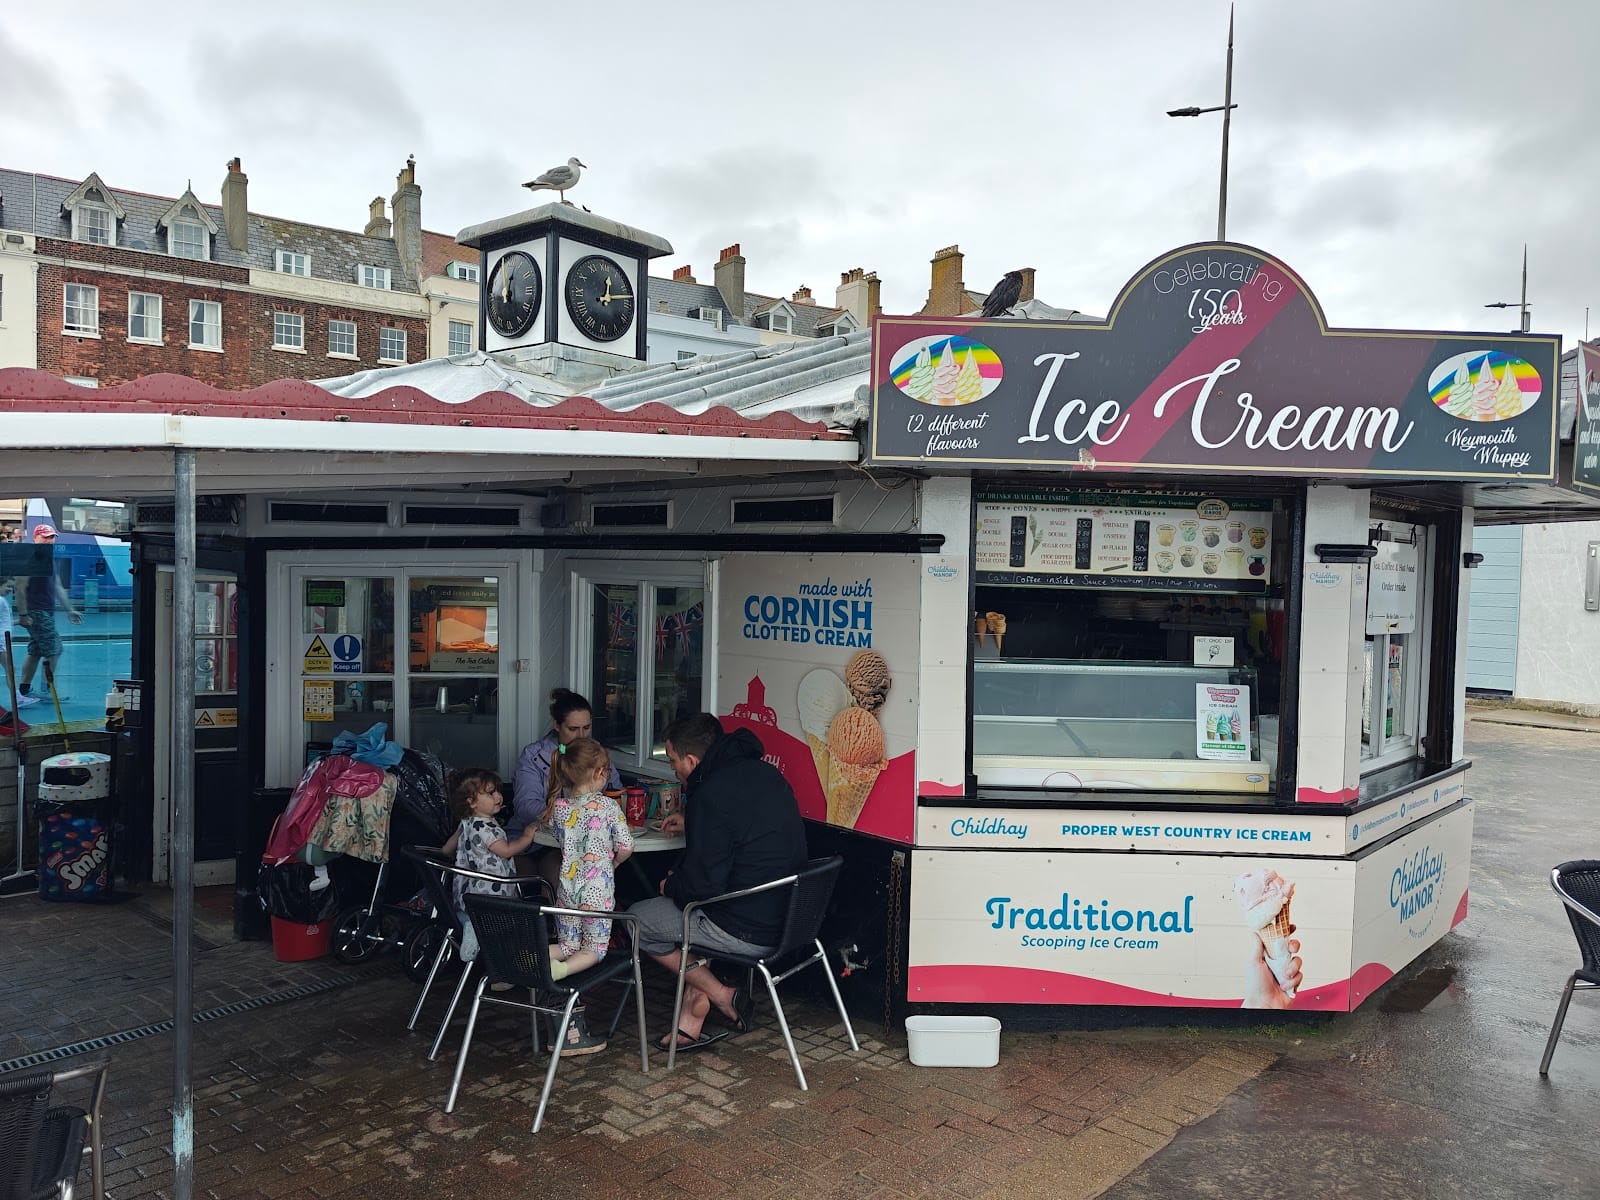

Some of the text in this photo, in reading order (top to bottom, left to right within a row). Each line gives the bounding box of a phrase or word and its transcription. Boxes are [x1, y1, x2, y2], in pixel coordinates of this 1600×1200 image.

[1154, 257, 1283, 301] Celebrating
[1188, 289, 1242, 318] 150
[1191, 310, 1247, 333] years
[1017, 352, 1414, 453] Ice Cream
[907, 412, 989, 436] 12 different
[926, 435, 980, 456] flavours
[1445, 427, 1518, 451] Weymouth
[1474, 445, 1531, 468] Whippy
[799, 577, 872, 598] made with
[1046, 575, 1075, 585] inside
[1381, 582, 1394, 592] Order
[744, 595, 872, 630] CORNISH
[743, 624, 872, 649] CLOTTED CREAM
[334, 663, 350, 671] Keep
[950, 817, 1028, 839] Childhay
[1062, 824, 1312, 842] PROPER WEST COUNTRY ICE CREAM
[1390, 845, 1443, 908] Childhay
[986, 893, 1194, 933] Traditional
[1400, 883, 1433, 924] MANOR
[1021, 935, 1159, 950] Scooping Ice Cream
